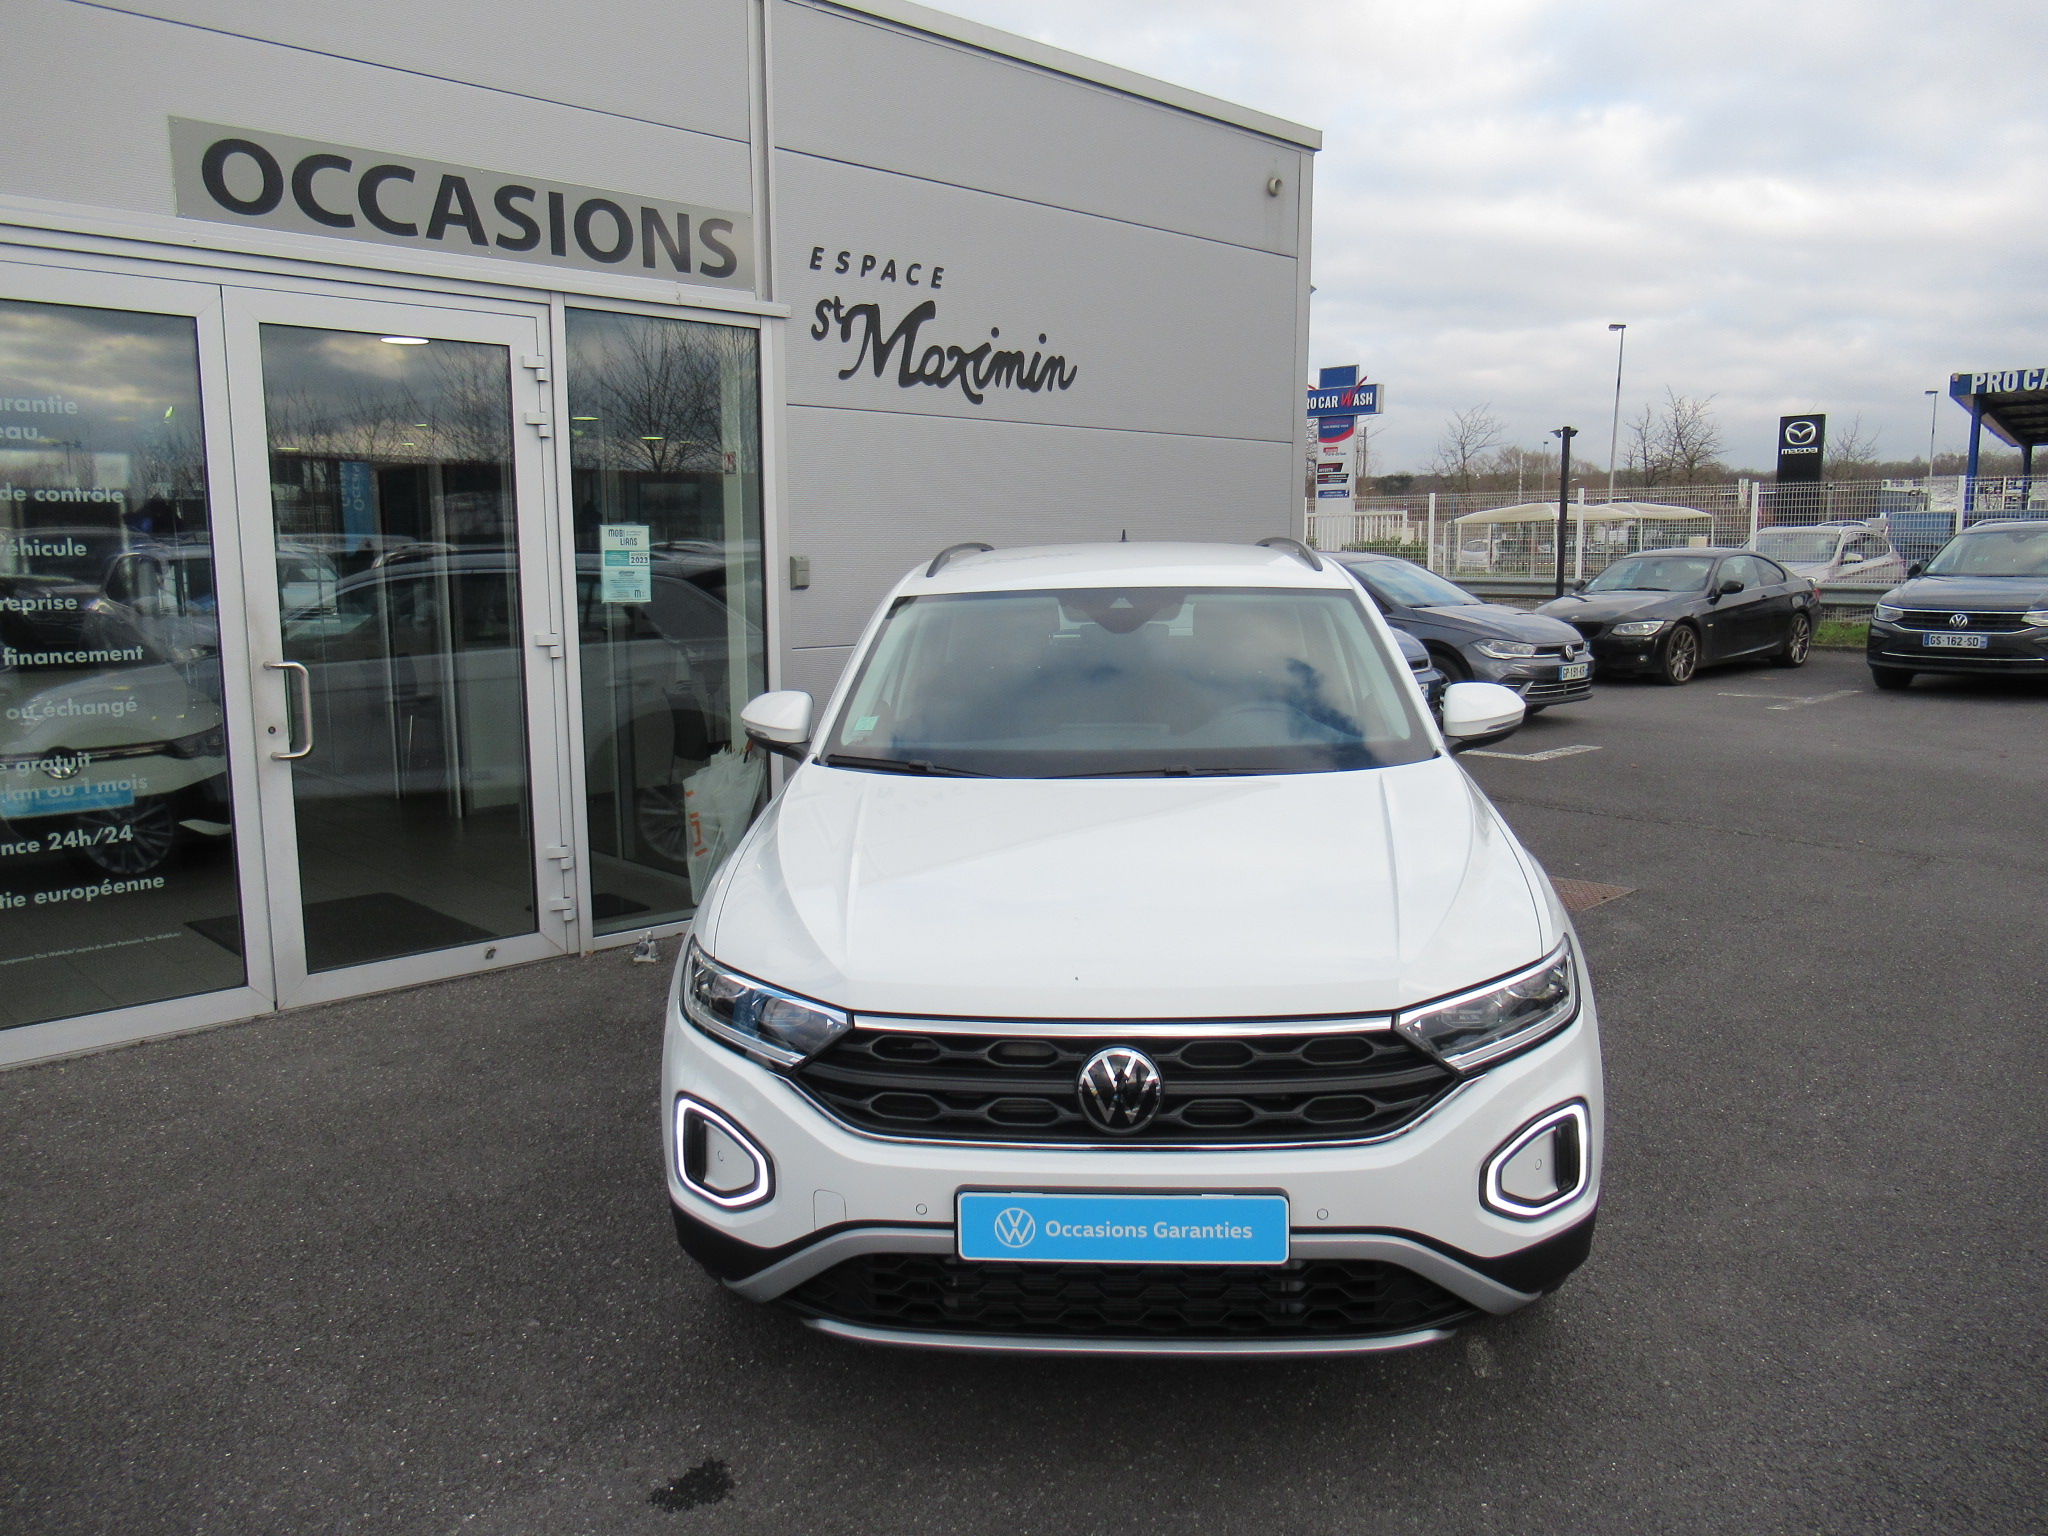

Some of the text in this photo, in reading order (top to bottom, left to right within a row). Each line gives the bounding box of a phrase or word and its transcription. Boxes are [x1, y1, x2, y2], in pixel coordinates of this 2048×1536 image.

[201, 139, 739, 279] OCCASIONS
[809, 246, 945, 289] ESPACE
[811, 295, 1078, 405] St Maximin
[1970, 370, 2018, 394] PRO
[0, 395, 78, 415] rantie
[1318, 395, 1338, 409] CAR
[1341, 389, 1374, 408] WASH
[1781, 446, 1818, 455] mazda
[34, 486, 124, 503] contrôle
[631, 556, 648, 564] 2023
[0, 593, 78, 615] reprise
[3, 646, 144, 666] financement
[6, 696, 138, 720] ou échangé
[16, 750, 92, 777] gratuit
[6, 783, 40, 801] km
[47, 785, 75, 798] ou
[81, 777, 91, 794] 1
[97, 773, 148, 793] mois
[47, 824, 134, 851] 24h/24
[34, 875, 165, 905] européenne
[1045, 1220, 1147, 1239] Occasions
[1153, 1221, 1253, 1240] Garanties
